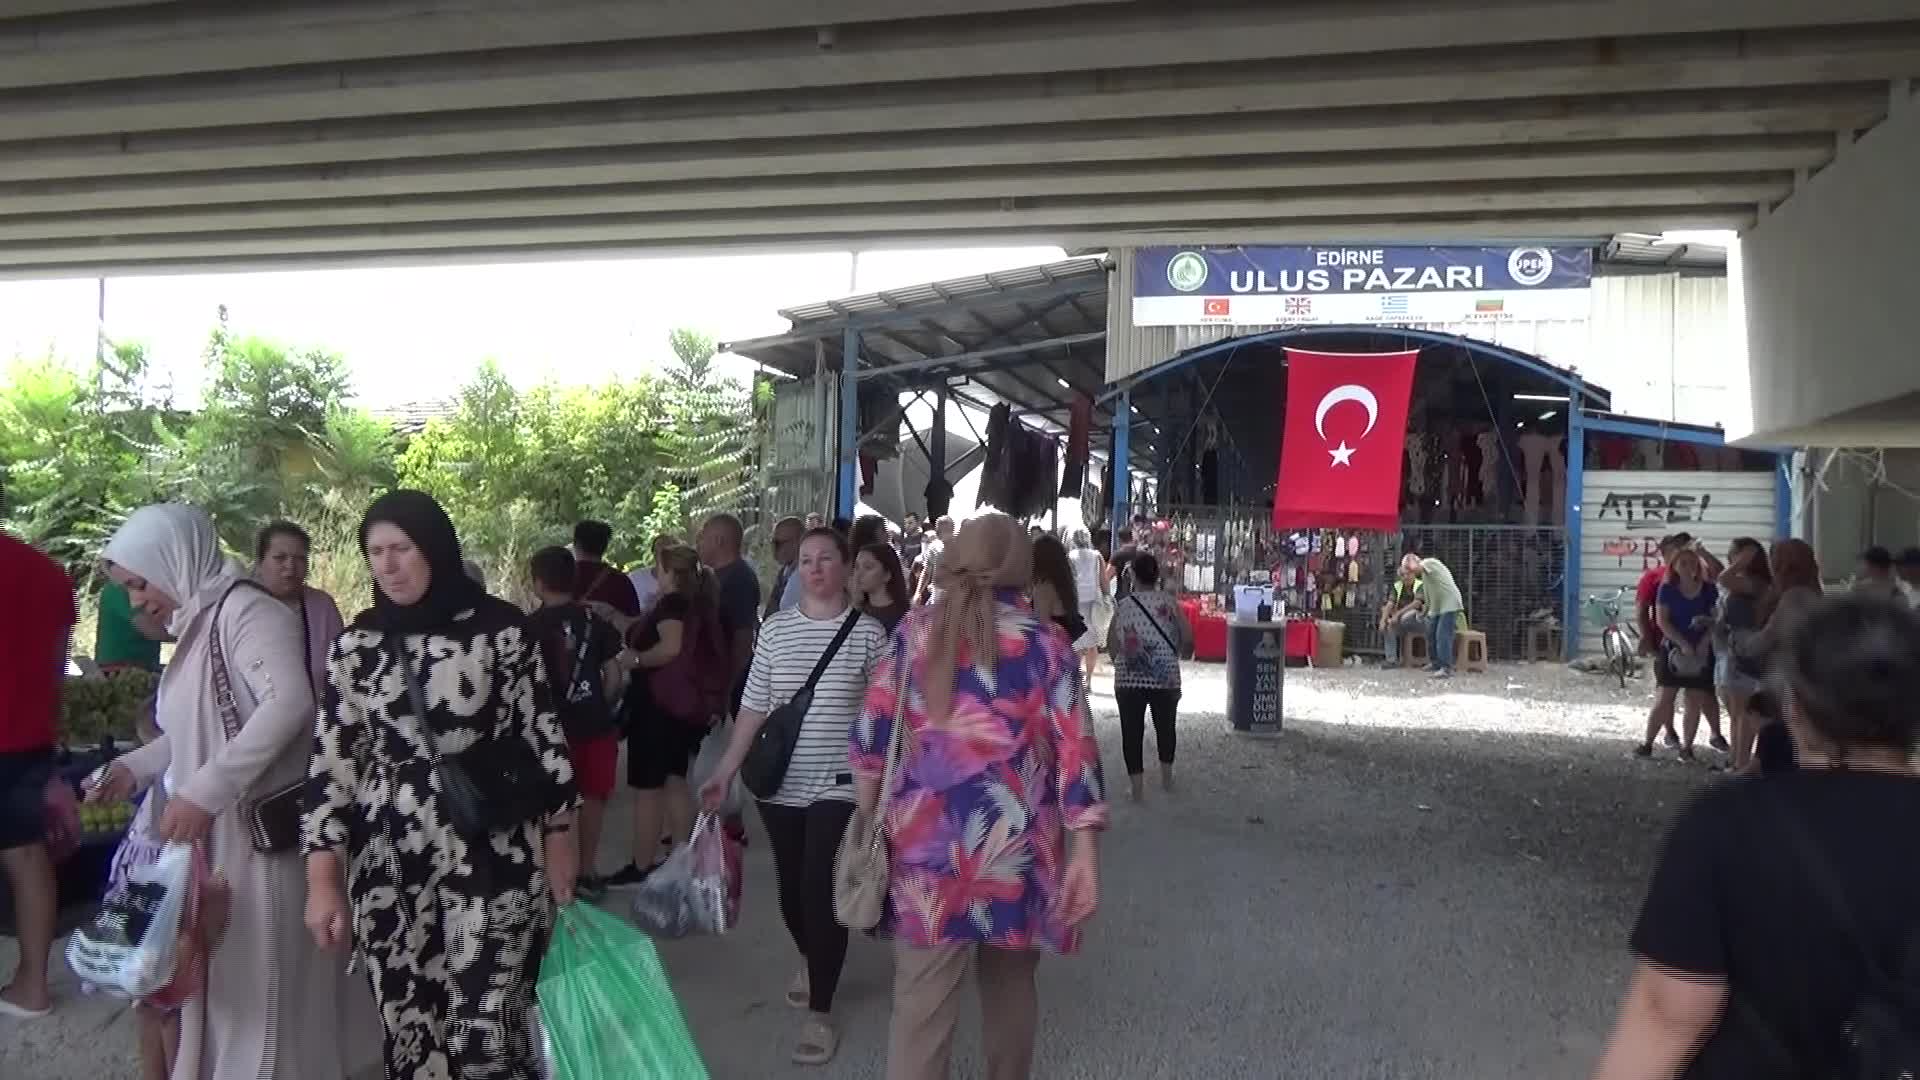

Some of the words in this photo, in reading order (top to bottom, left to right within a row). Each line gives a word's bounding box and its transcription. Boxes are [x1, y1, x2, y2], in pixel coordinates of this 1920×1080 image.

[1316, 248, 1383, 265] EDİRNE
[1230, 270, 1330, 292] ULUS
[1343, 265, 1483, 291] PAZARI
